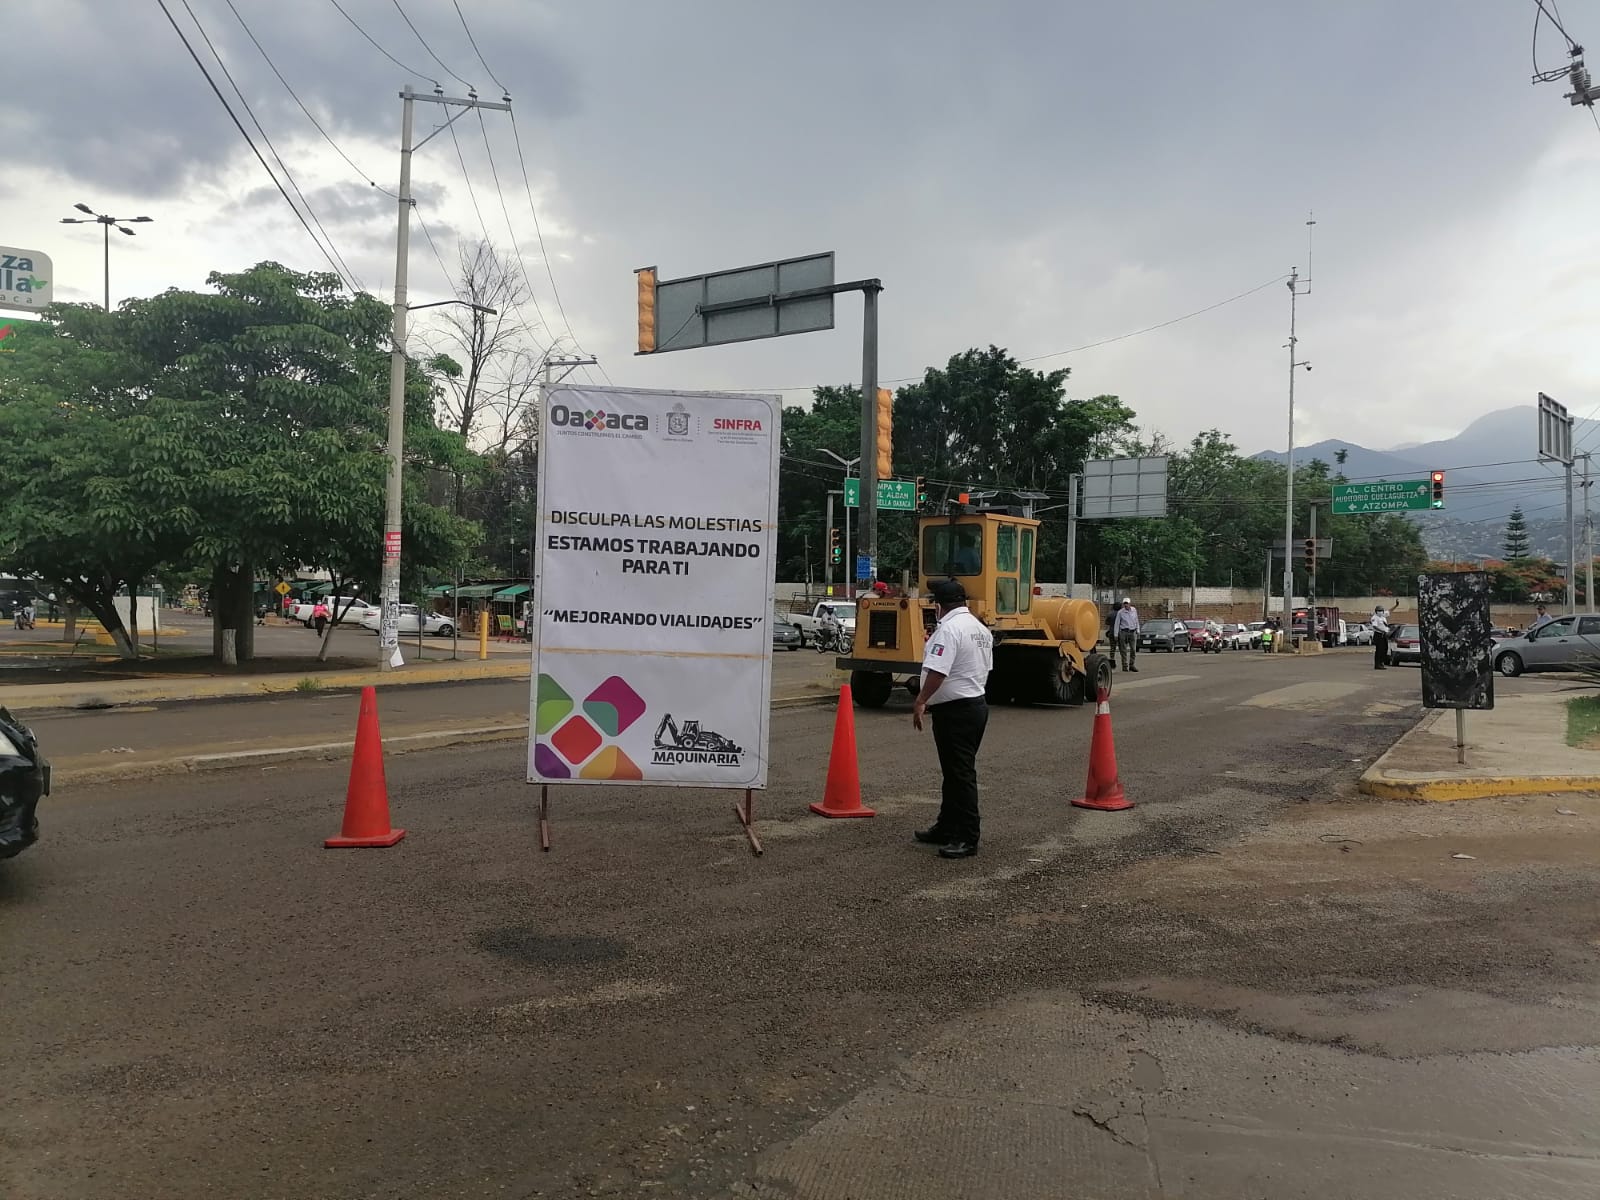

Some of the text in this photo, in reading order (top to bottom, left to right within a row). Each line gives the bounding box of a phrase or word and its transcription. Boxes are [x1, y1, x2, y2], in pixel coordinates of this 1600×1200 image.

[0, 269, 32, 293] la
[551, 405, 648, 431] Oaxaca
[713, 418, 762, 431] SINFRA
[1364, 485, 1403, 493] CENTRO
[1362, 502, 1409, 510] ATZOMPA
[551, 510, 762, 533] DISCULPA LAS MOLESTIAS
[548, 535, 760, 558] ESTAMOS TRABAJANDO
[622, 559, 689, 576] PARA TI
[544, 610, 762, 630] “MEJORANDO VIALIDADES”
[653, 751, 739, 764] MAQUINARIA
